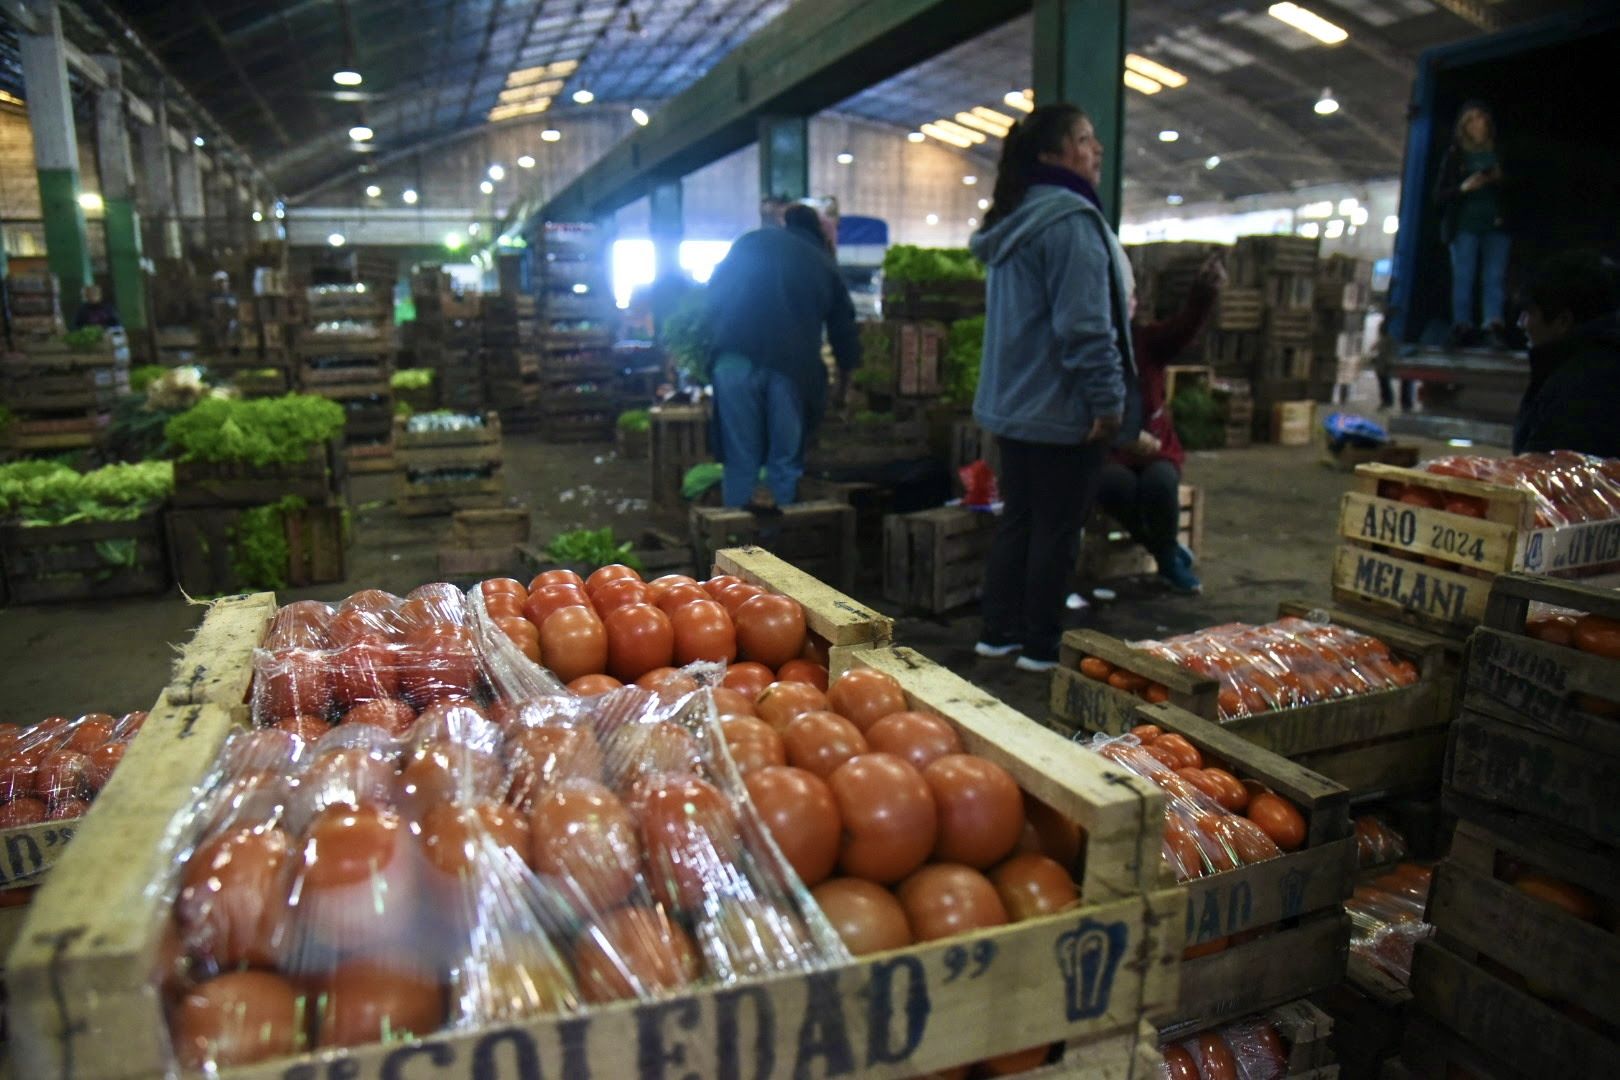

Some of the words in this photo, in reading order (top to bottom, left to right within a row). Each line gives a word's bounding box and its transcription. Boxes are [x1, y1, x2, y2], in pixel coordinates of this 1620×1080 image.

[1360, 504, 1416, 546] AÑO
[1431, 525, 1485, 563] 2024
[1353, 554, 1467, 619] MELANI
